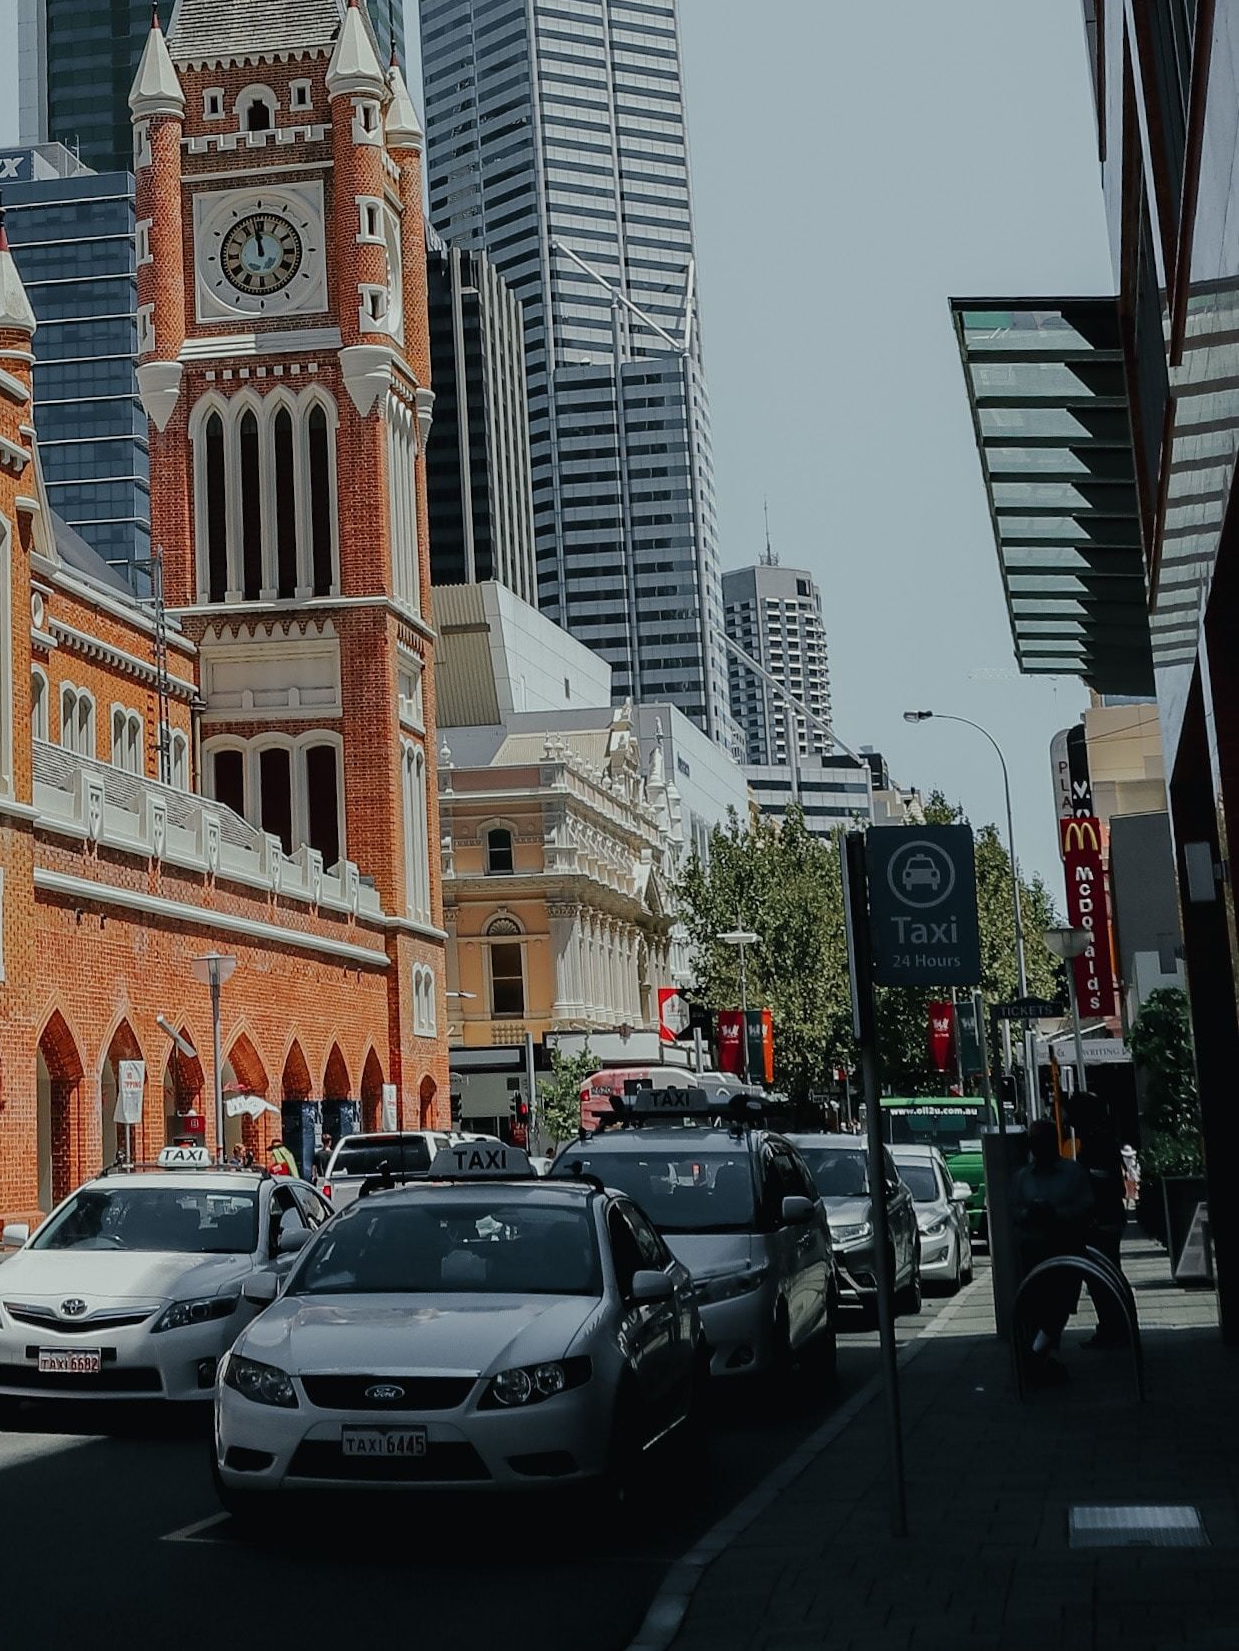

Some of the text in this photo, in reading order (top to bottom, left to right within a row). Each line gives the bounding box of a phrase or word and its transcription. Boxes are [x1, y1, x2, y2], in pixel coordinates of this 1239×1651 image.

[1058, 761, 1074, 818] PLA
[890, 915, 958, 944] Taxi
[893, 954, 961, 968] 24 Hours
[1001, 1005, 1053, 1017] TICKETS
[650, 1091, 690, 1107] TAXI
[164, 1150, 203, 1161] TAXI
[453, 1150, 506, 1170] TAXI
